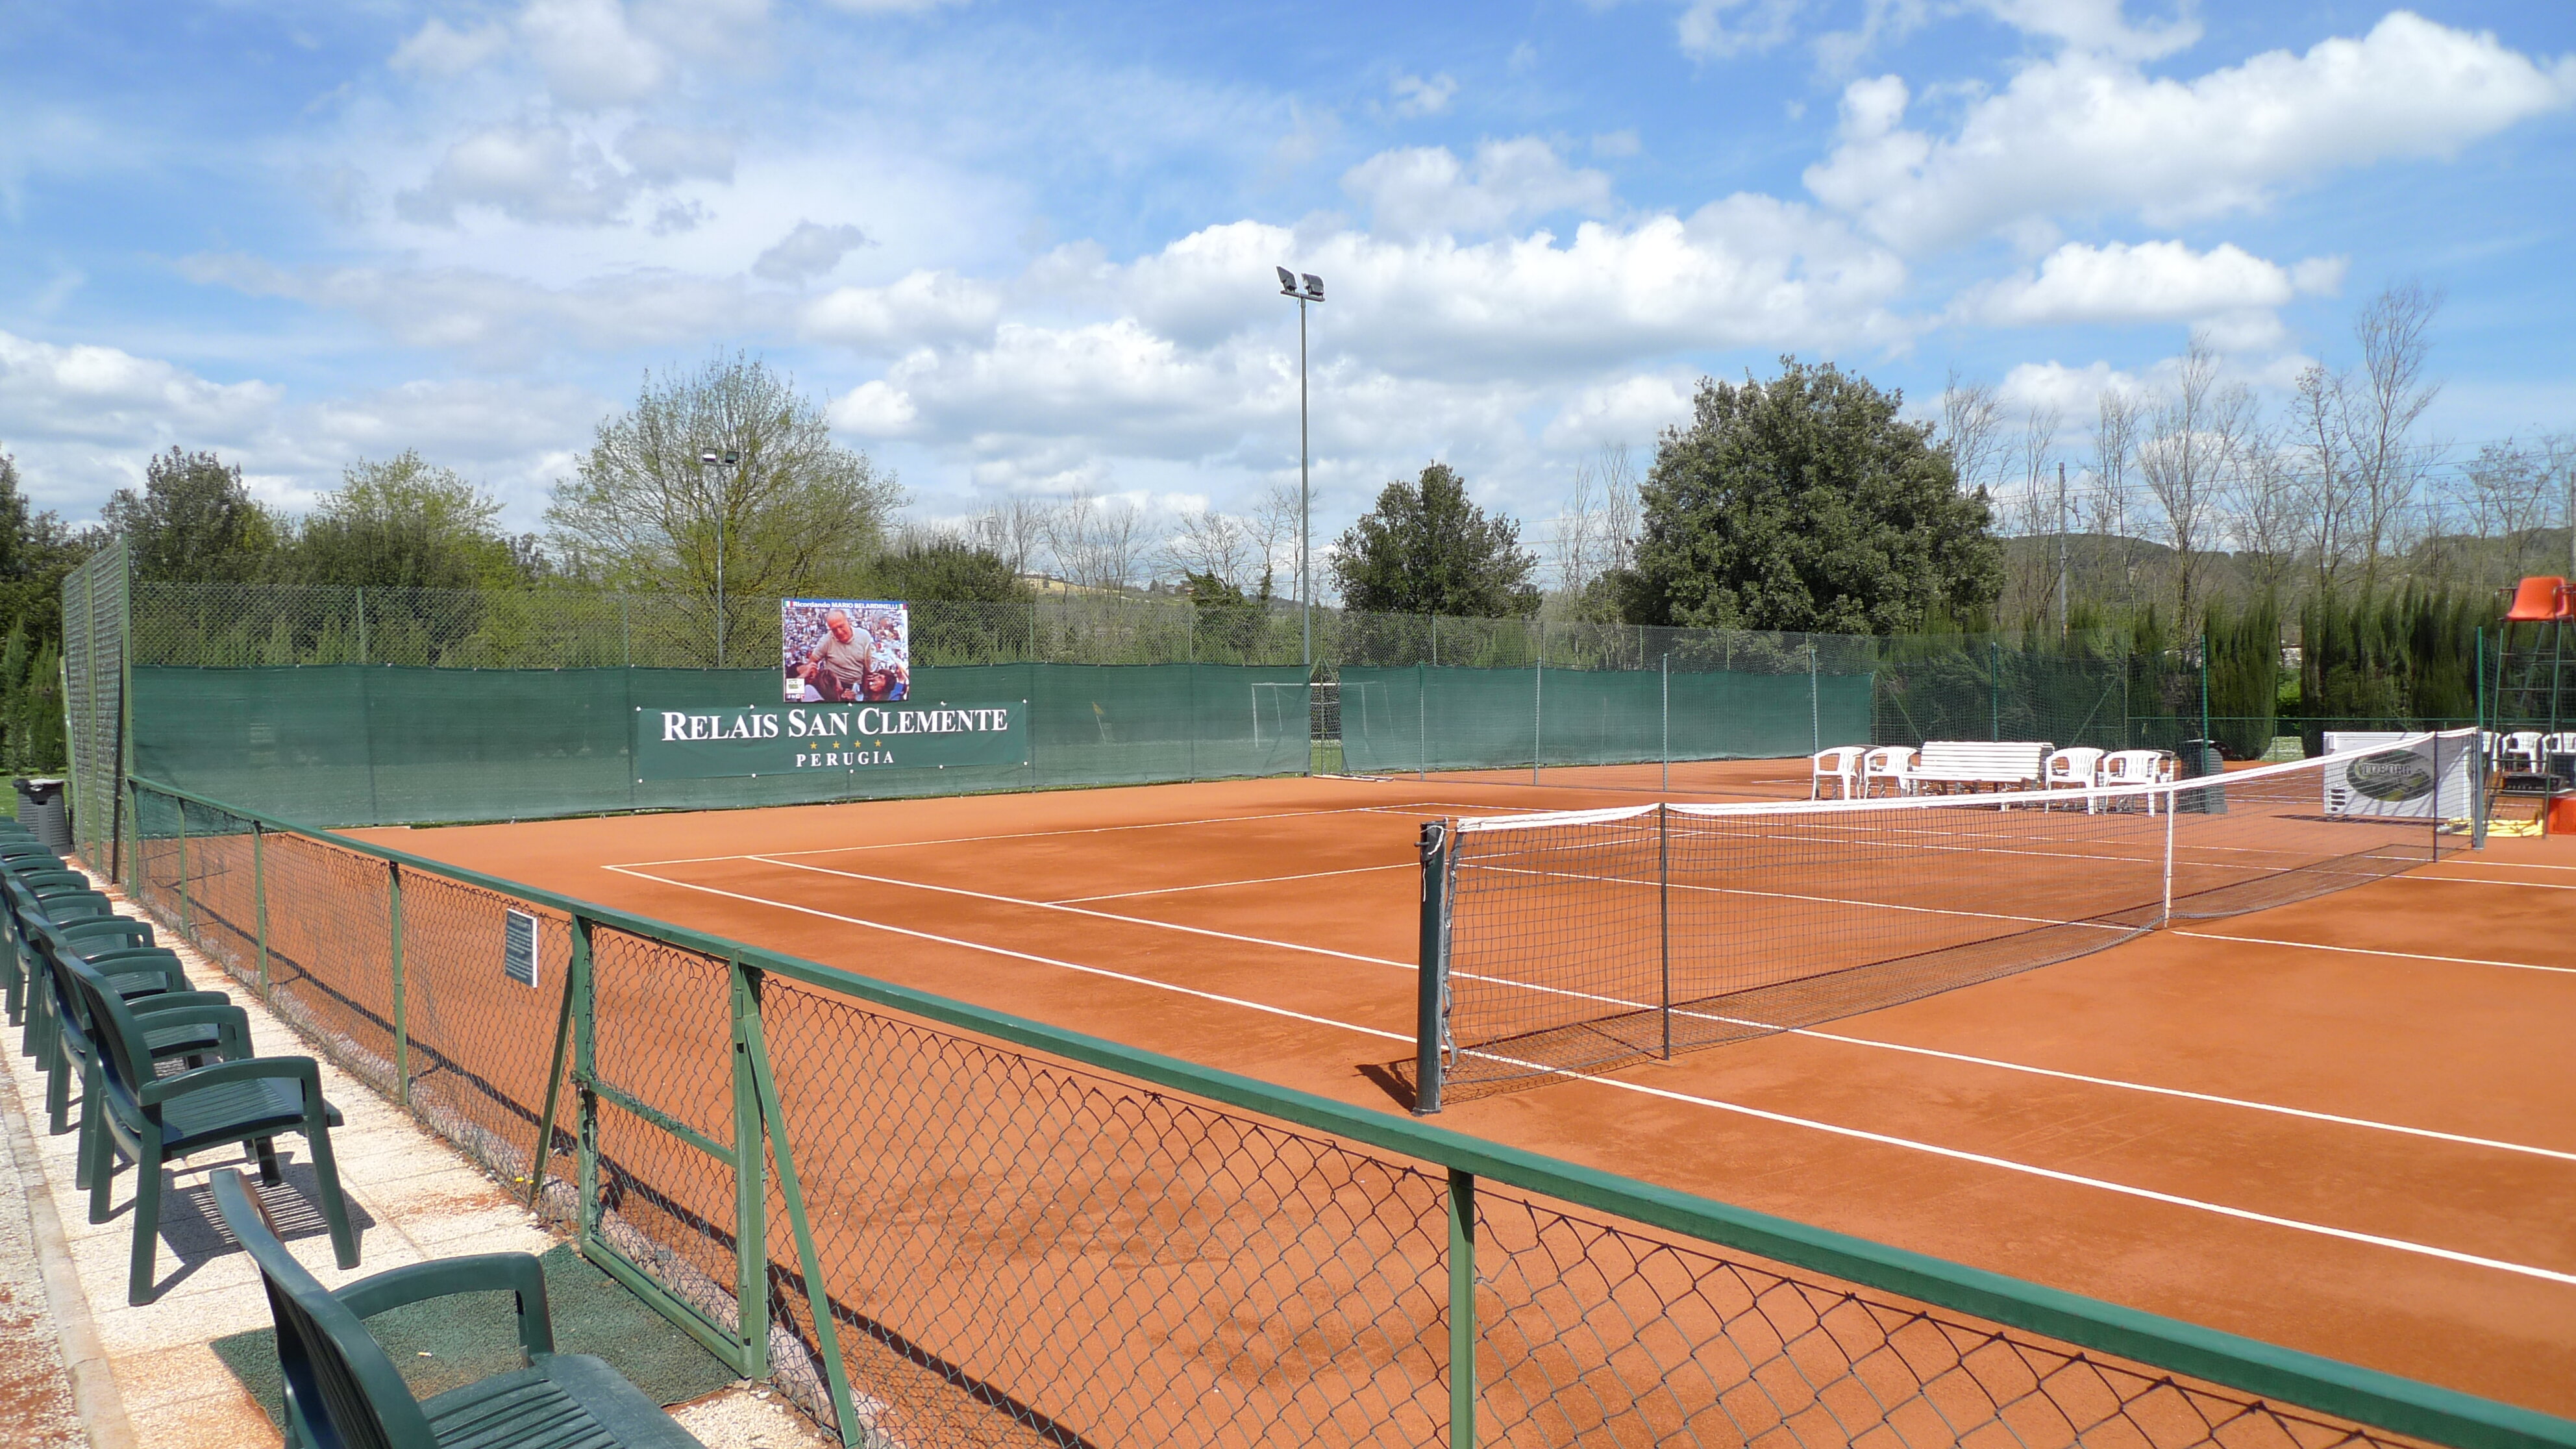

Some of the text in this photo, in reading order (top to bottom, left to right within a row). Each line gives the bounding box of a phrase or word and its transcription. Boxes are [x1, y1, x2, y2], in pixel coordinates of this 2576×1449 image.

[661, 707, 1008, 741] RELAIS SAN CLEMENTE
[795, 750, 894, 767] PERUGIA
[2361, 763, 2412, 776] TUBORG
